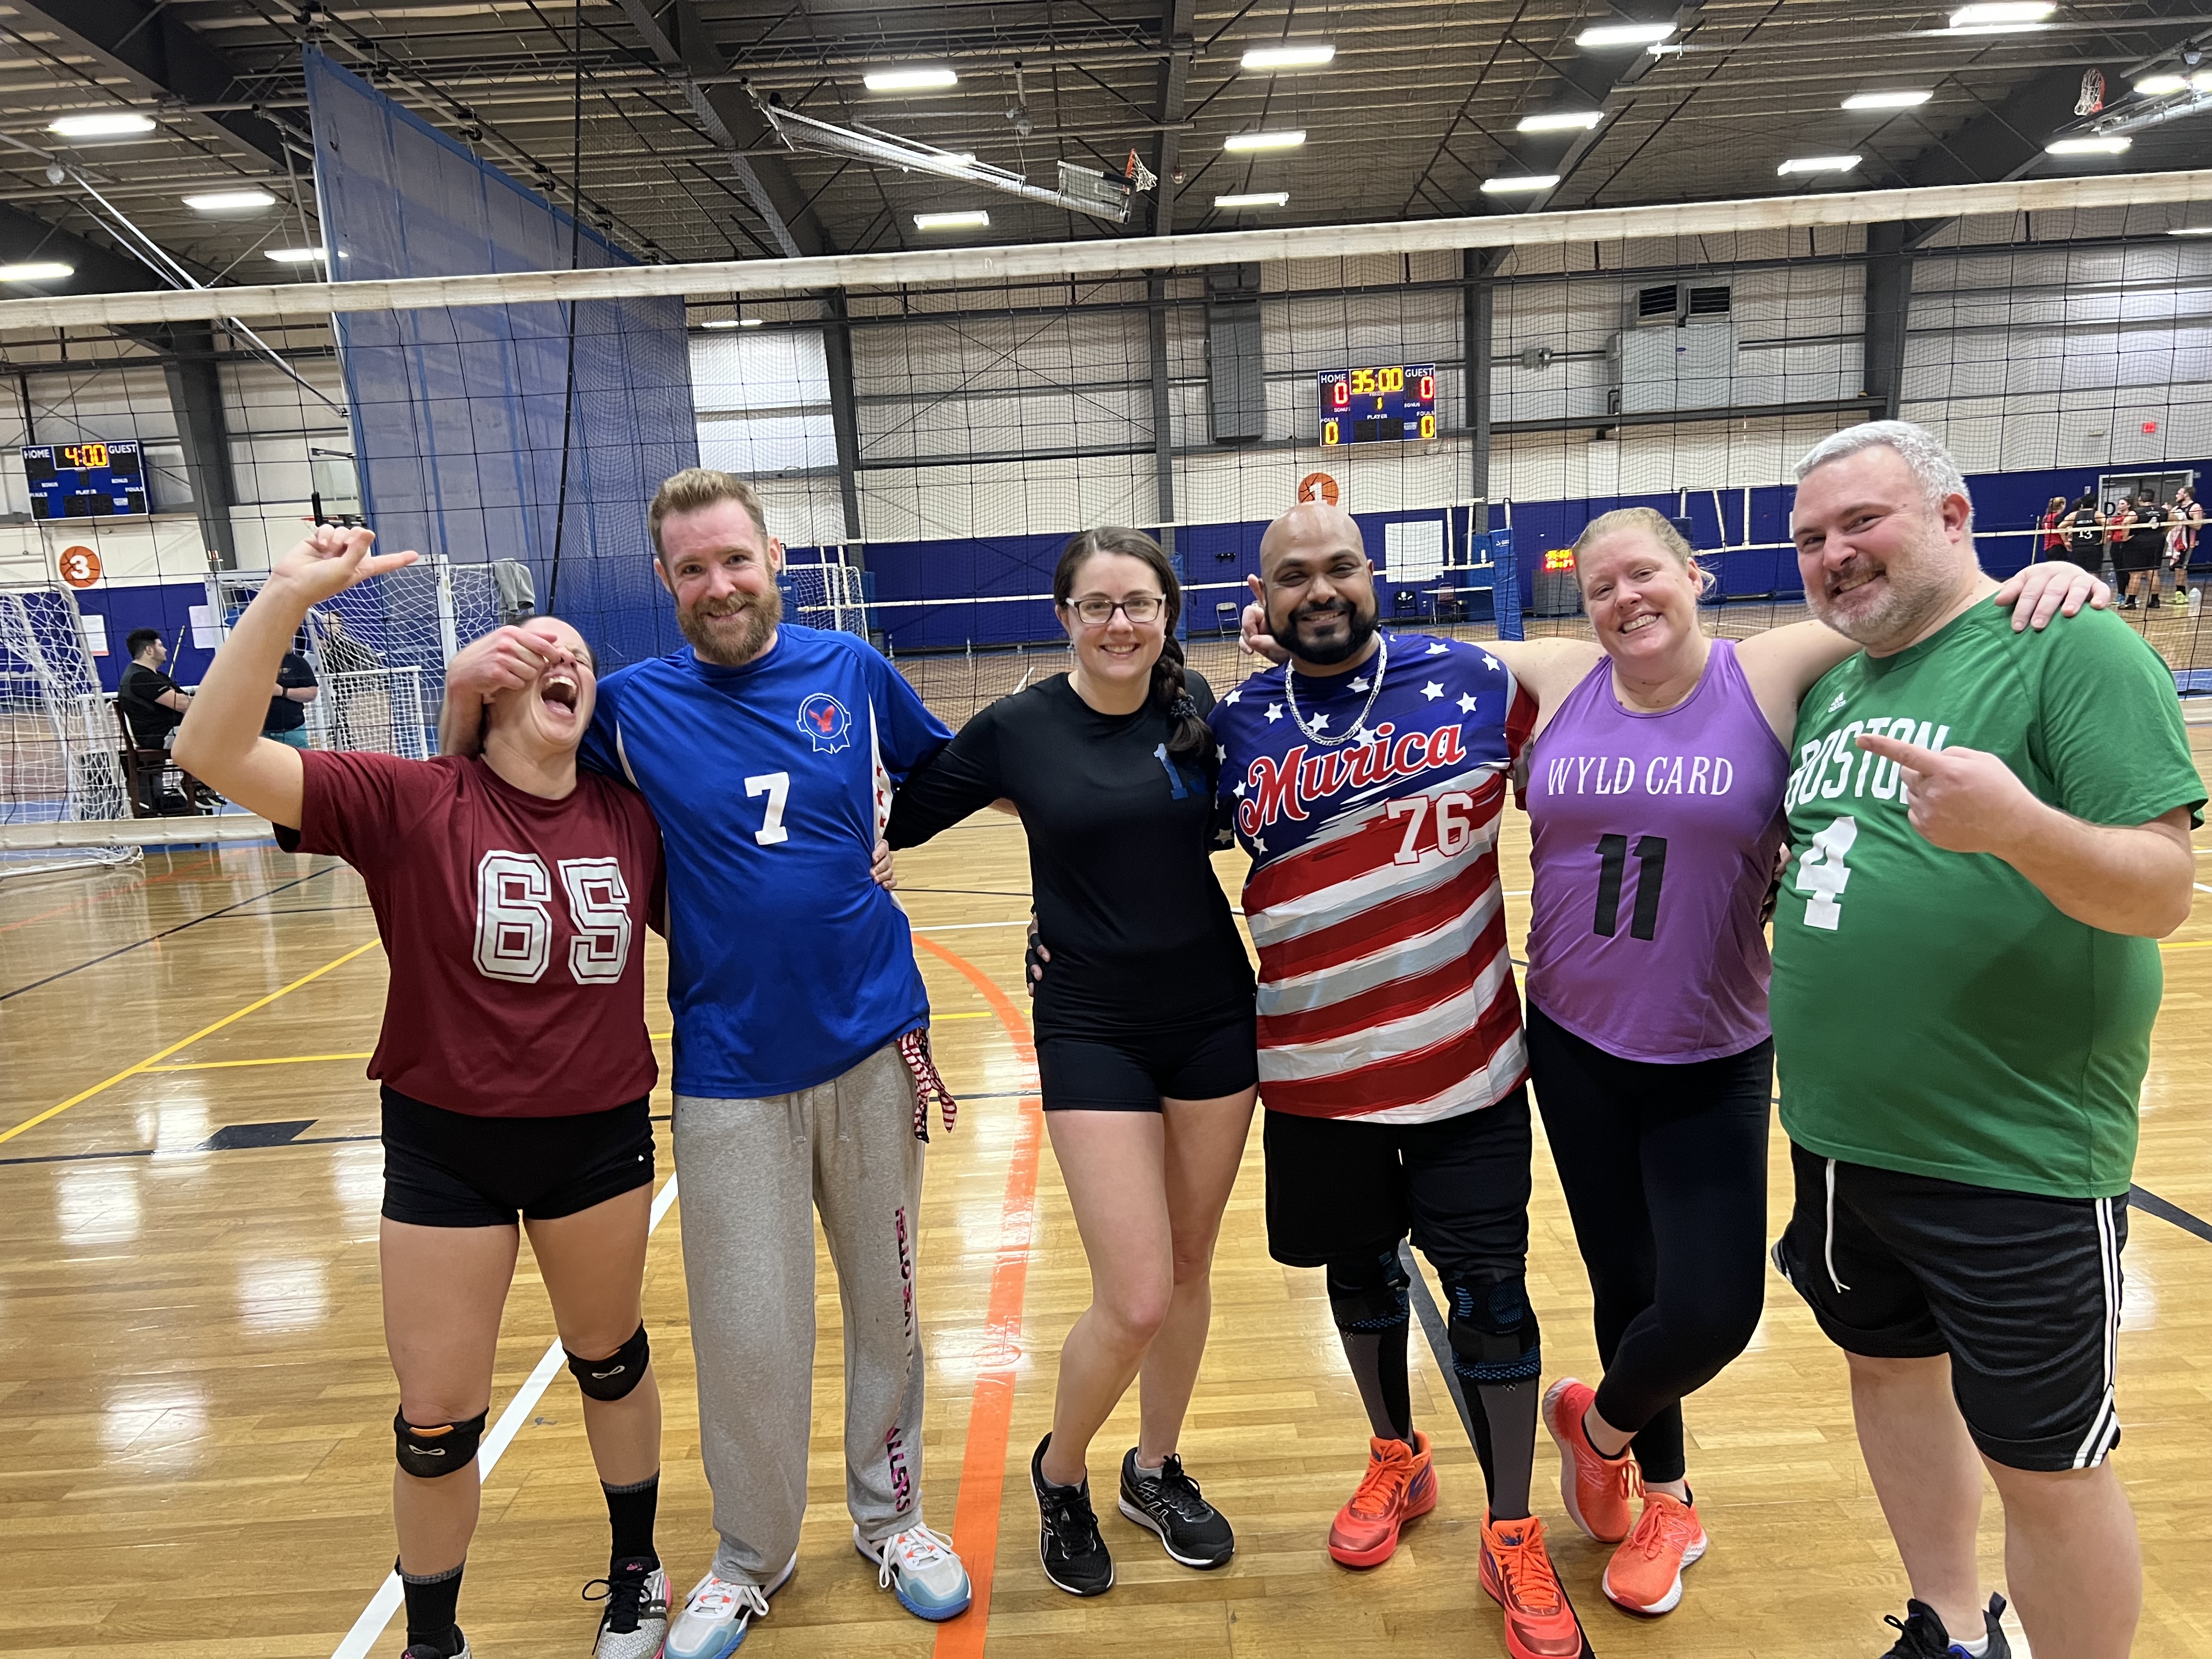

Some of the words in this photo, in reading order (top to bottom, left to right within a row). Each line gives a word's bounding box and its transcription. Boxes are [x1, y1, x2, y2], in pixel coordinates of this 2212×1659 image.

[1321, 374, 1346, 383] HOME
[1352, 368, 1403, 393] 35:00
[1405, 368, 1433, 377] GUEST
[1334, 382, 1348, 404] 0
[1421, 376, 1434, 399] 0
[1325, 422, 1339, 444] 0
[1421, 415, 1434, 438] 0
[24, 449, 51, 459] HOME
[65, 444, 107, 466] 4:00
[108, 444, 137, 454] GUEST
[70, 555, 89, 579] 3
[1239, 722, 1466, 837] Murica
[1548, 757, 1635, 795] WYLD
[1645, 757, 1733, 795] CARD
[744, 772, 790, 845] 7
[1385, 791, 1473, 866] 76
[1795, 816, 1858, 930] 4
[1593, 833, 1667, 941] 11
[472, 850, 632, 985] 65
